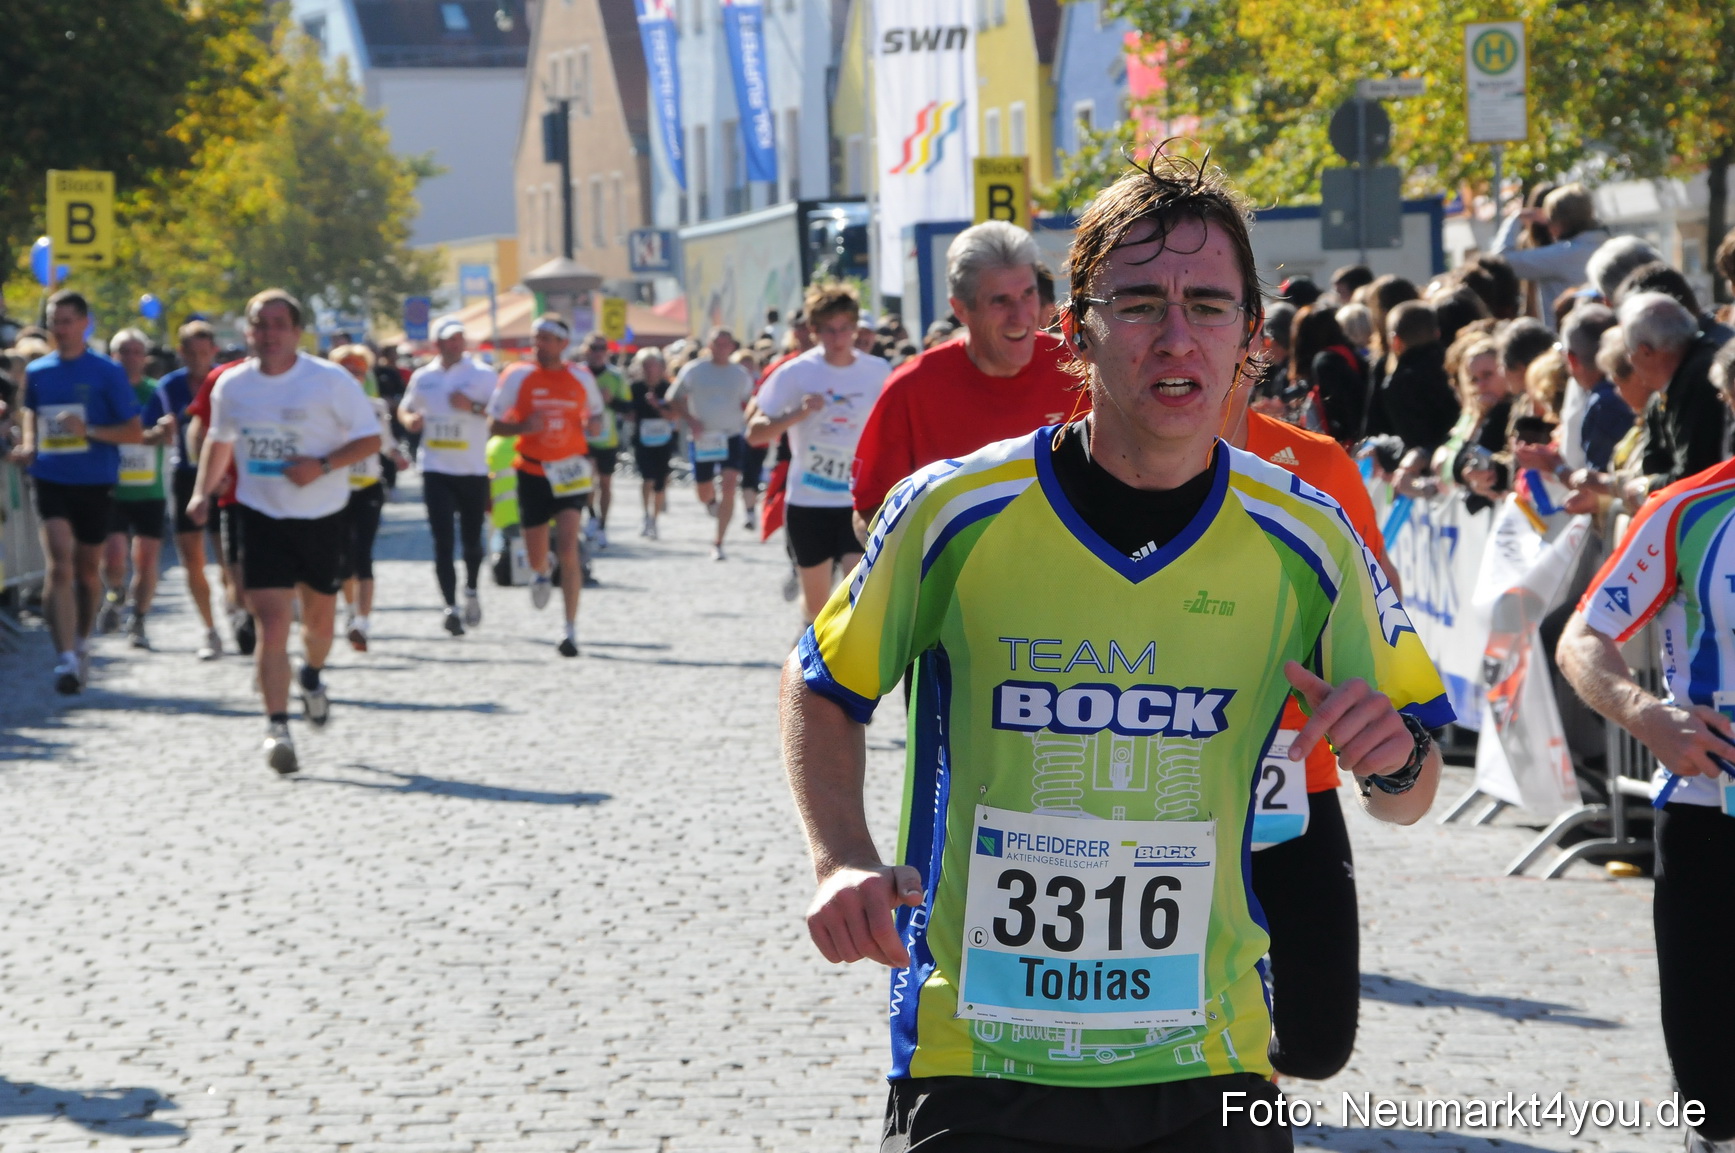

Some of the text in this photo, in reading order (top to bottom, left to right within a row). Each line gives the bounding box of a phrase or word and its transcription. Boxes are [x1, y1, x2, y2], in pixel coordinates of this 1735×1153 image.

[882, 25, 968, 53] swn
[67, 202, 97, 244] B
[988, 184, 1016, 227] B
[248, 438, 297, 458] 2295
[1270, 456, 1299, 466] adidas
[1290, 474, 1417, 648] BCK
[999, 636, 1156, 675] TEAM
[993, 680, 1236, 738] BOCK
[1255, 764, 1288, 810] 2
[1006, 831, 1110, 858] PFLEIDERER
[1006, 852, 1110, 869] AKTIENGESELLSCHAFT
[1135, 845, 1198, 859] BOCK
[992, 868, 1182, 953] 3316
[1019, 956, 1151, 1001] Tobias
